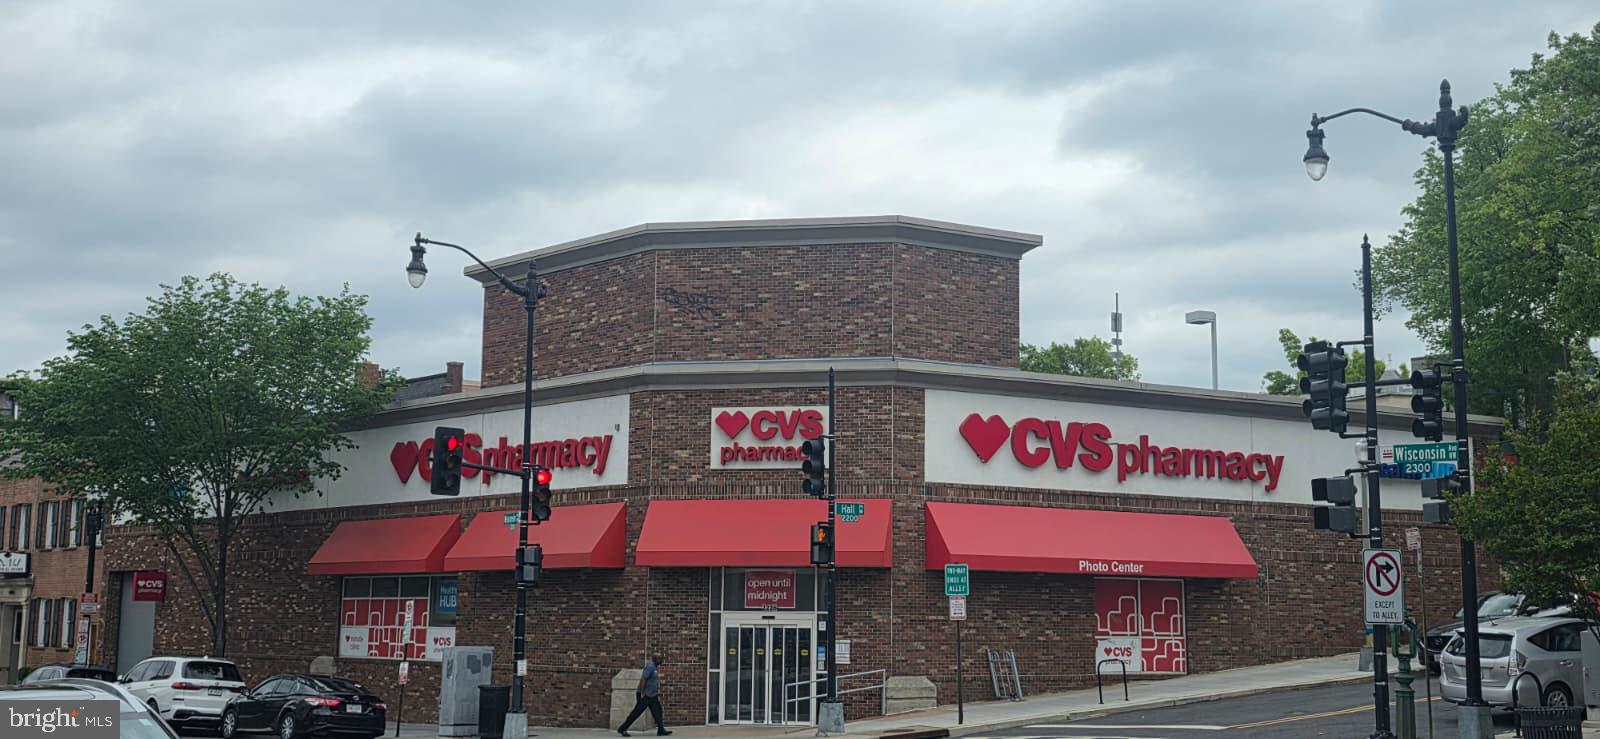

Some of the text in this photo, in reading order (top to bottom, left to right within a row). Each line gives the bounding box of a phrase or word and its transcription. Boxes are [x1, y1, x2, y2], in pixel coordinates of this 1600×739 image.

[751, 410, 824, 440] CVS
[720, 442, 808, 466] pharmac
[1011, 418, 1285, 492] CVS pharmacy
[1395, 445, 1446, 461] Wisconsin
[1406, 463, 1431, 473] 2300
[841, 503, 855, 514] Hall
[1079, 560, 1144, 573] Photo Center
[146, 580, 163, 588] CVS
[748, 578, 791, 588] open until
[440, 595, 457, 607] HUB
[748, 590, 787, 602] midnight
[1374, 600, 1395, 609] EXCEPT
[1382, 611, 1397, 619] ALLEY
[439, 637, 452, 646] CVS
[1113, 647, 1132, 657] CVS
